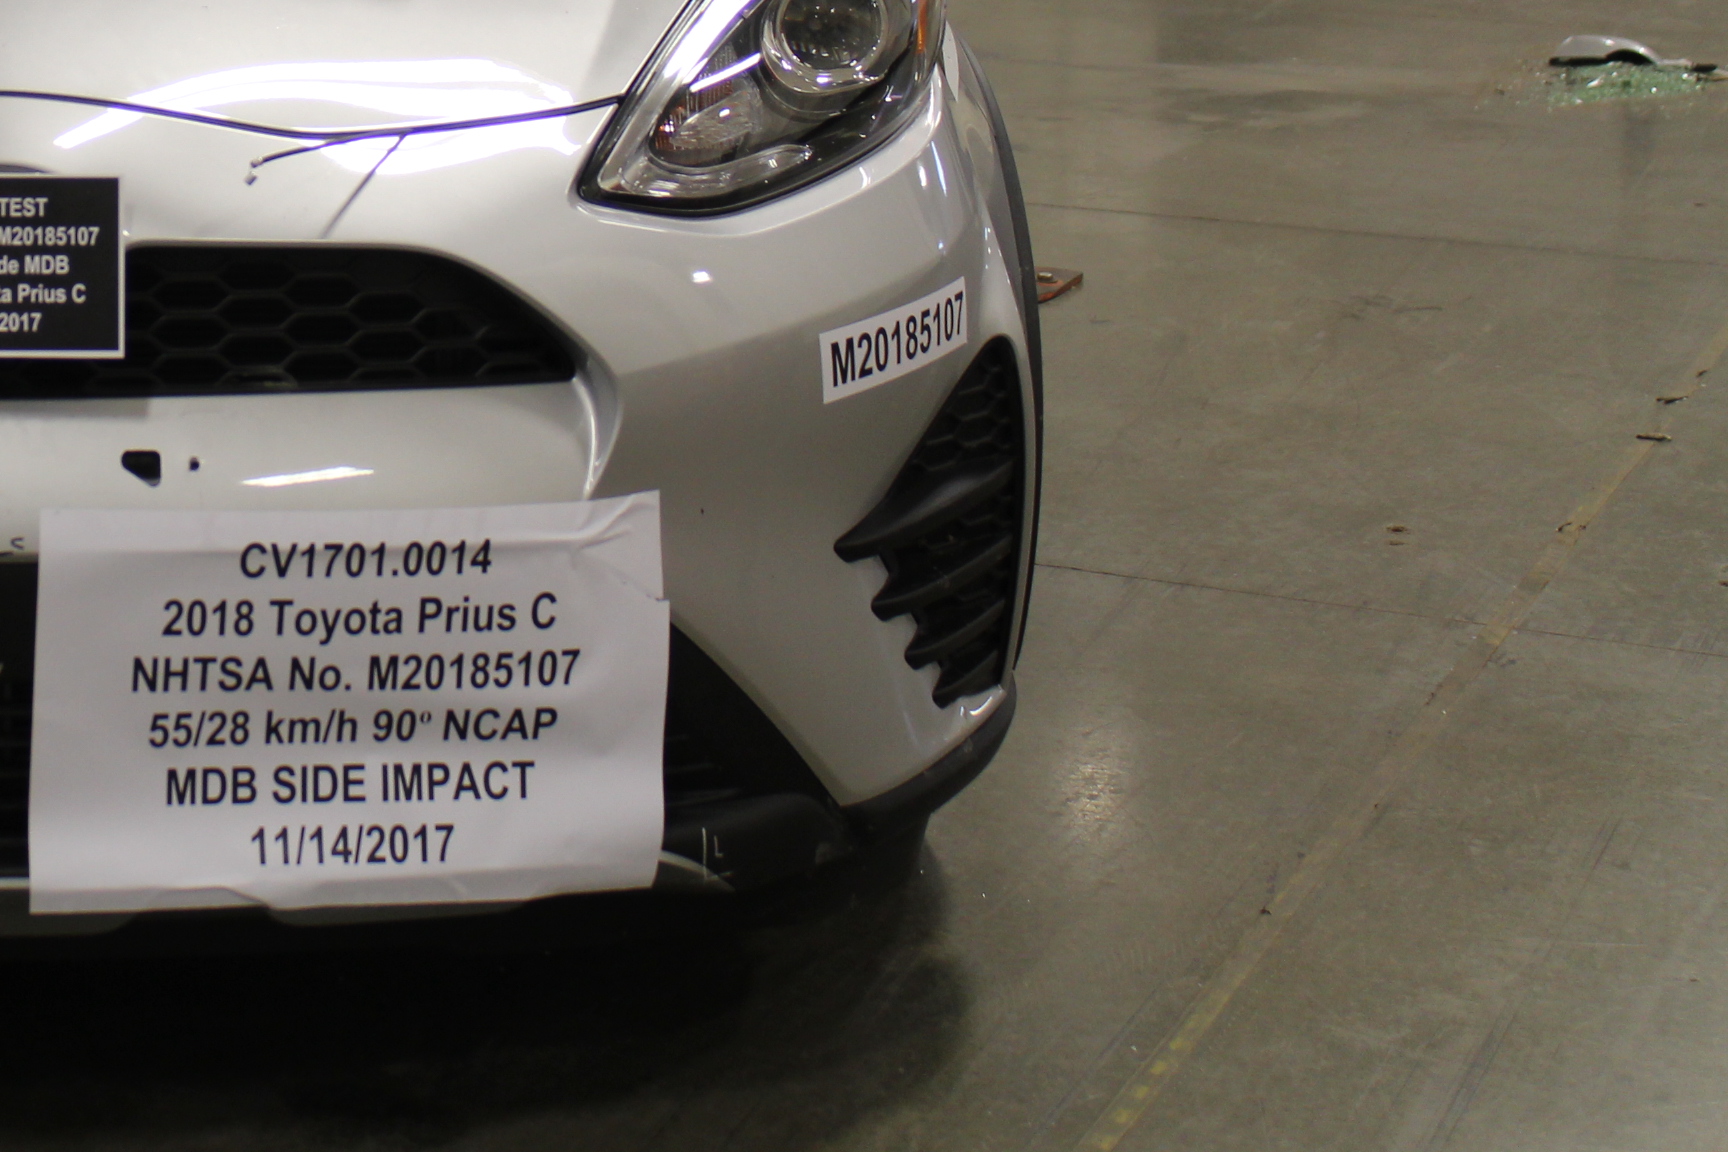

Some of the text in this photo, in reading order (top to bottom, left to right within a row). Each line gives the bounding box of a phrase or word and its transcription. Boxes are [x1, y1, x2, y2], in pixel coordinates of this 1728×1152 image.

[24, 254, 70, 275] MDB
[17, 283, 67, 304] Prius
[71, 283, 86, 304] C
[830, 291, 964, 388] M20185107
[239, 539, 492, 579] CV1701.0014
[162, 592, 557, 646] 2018 Toyota Prius C
[132, 648, 581, 693] NHTSA No. M20185107
[149, 710, 250, 749] 55/28
[265, 709, 358, 745] km/h
[443, 707, 558, 741] NCAP
[166, 760, 535, 806] MDB SIDE IMPACT
[251, 824, 454, 865] 11/14/2017
